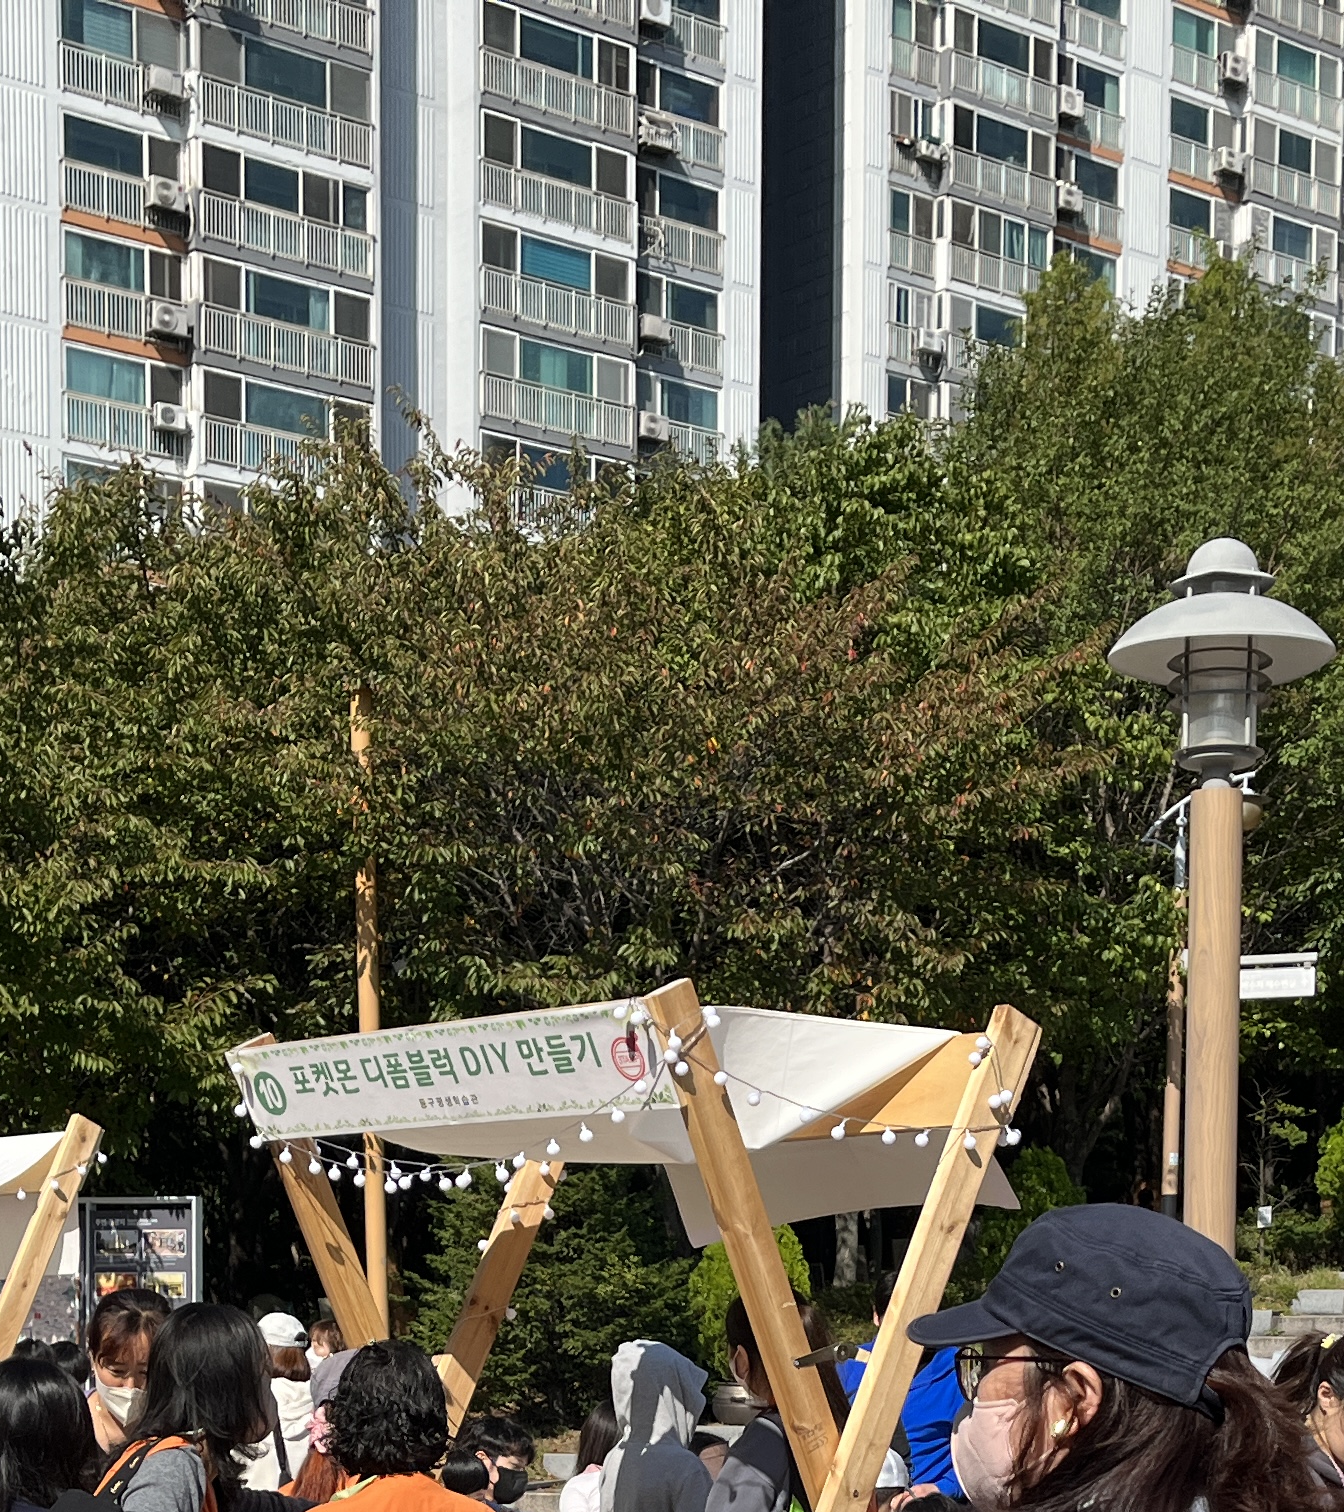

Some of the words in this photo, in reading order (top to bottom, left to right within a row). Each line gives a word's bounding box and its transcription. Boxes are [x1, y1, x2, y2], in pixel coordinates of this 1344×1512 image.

[288, 1058, 361, 1098] 포켓몬
[359, 1047, 460, 1090] 디폼블럭
[458, 1041, 510, 1076] DIY
[515, 1031, 602, 1077] 만들기
[258, 1077, 284, 1110] 10
